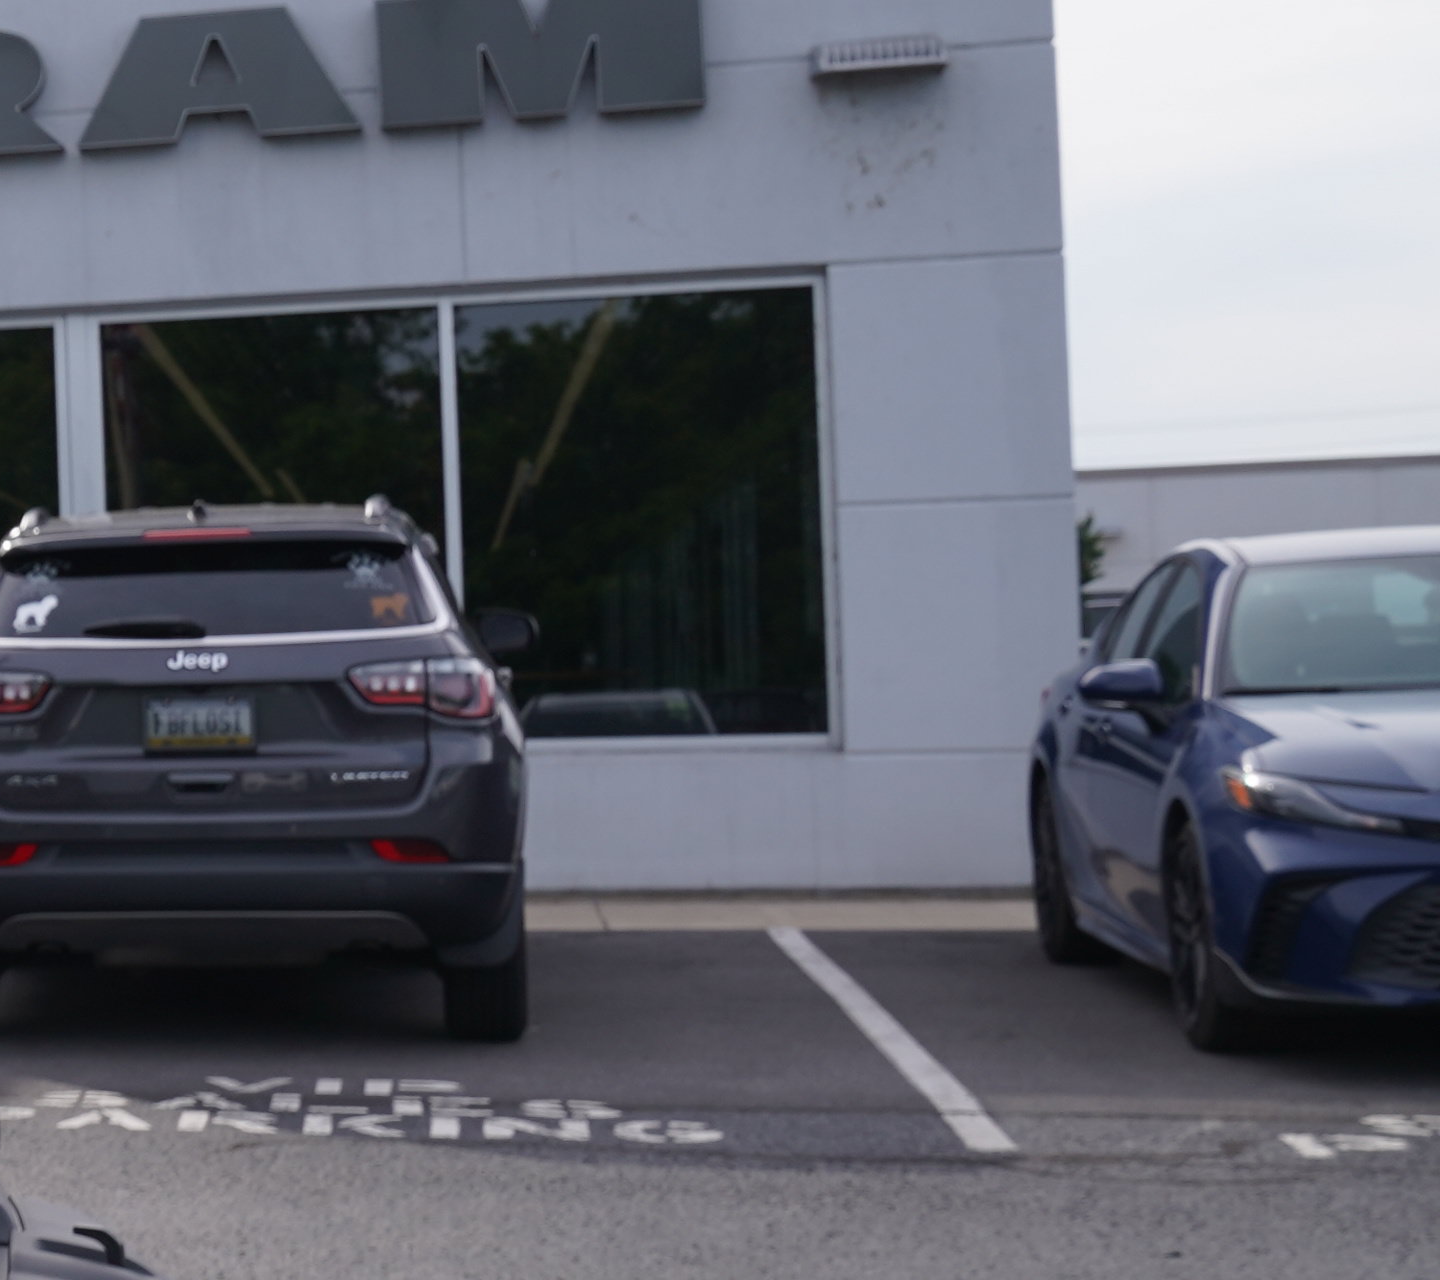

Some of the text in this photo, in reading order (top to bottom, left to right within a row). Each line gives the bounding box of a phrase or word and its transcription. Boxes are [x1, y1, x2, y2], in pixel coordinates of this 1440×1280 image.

[166, 649, 228, 673] Jeep
[204, 1075, 465, 1097] VIP
[33, 1089, 624, 1120] SALES
